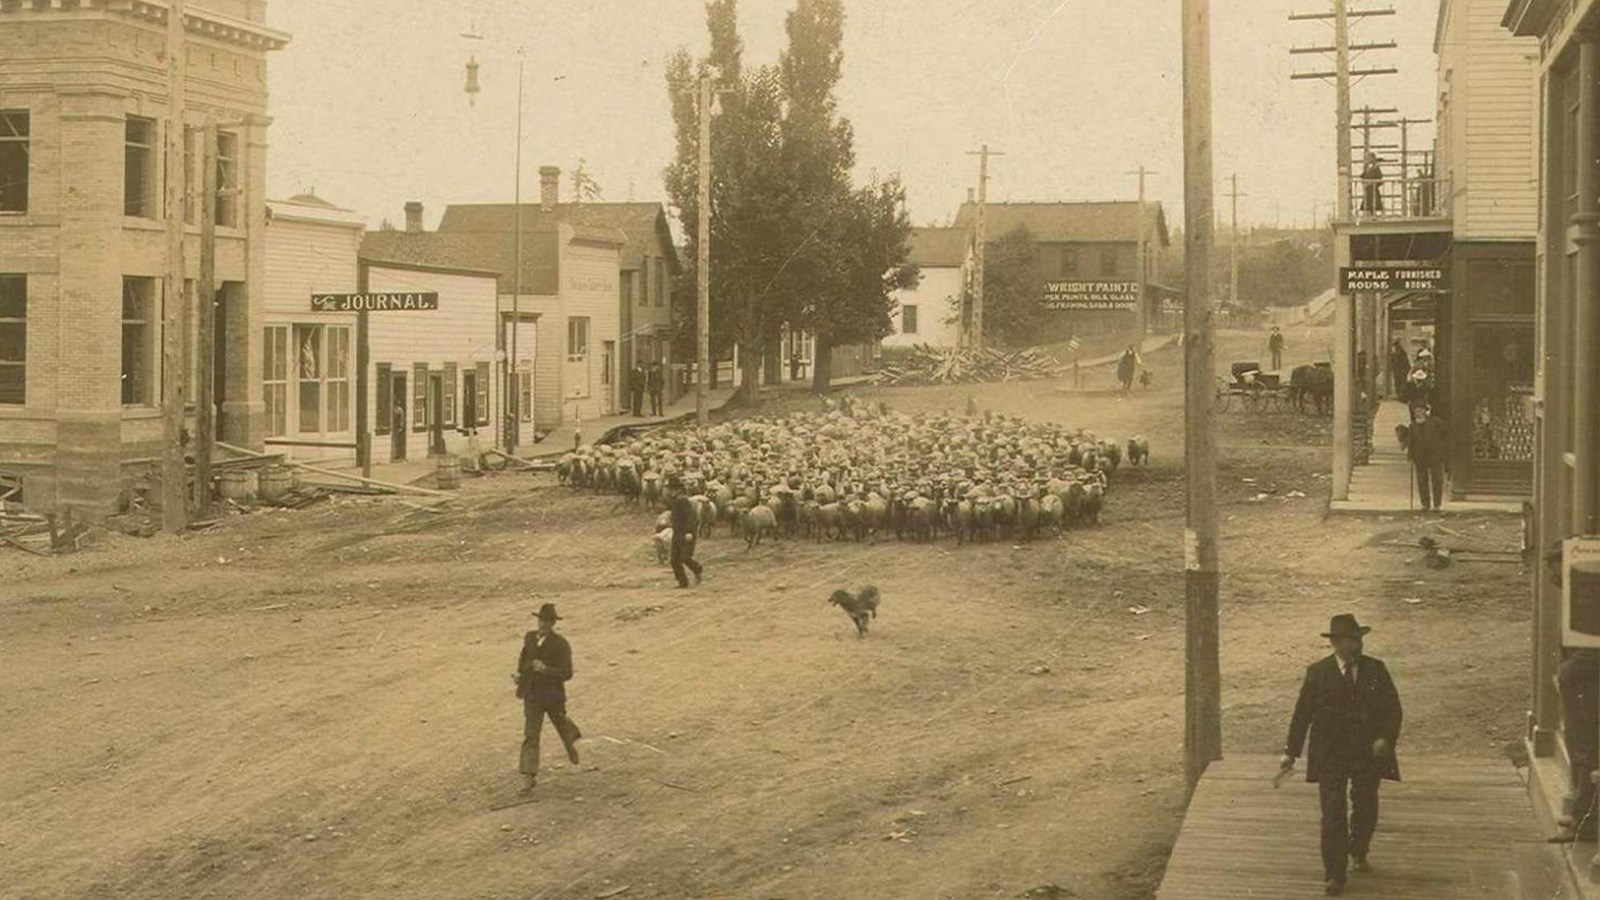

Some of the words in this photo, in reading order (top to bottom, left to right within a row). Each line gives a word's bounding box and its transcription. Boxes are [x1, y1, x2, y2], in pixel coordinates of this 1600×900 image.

[1348, 270, 1389, 279] MAPLE
[1395, 270, 1441, 279] FURNISHED
[1047, 282, 1095, 293] WRIGHT
[1348, 281, 1389, 289] HOUSE
[341, 294, 434, 310] JOURNAL.
